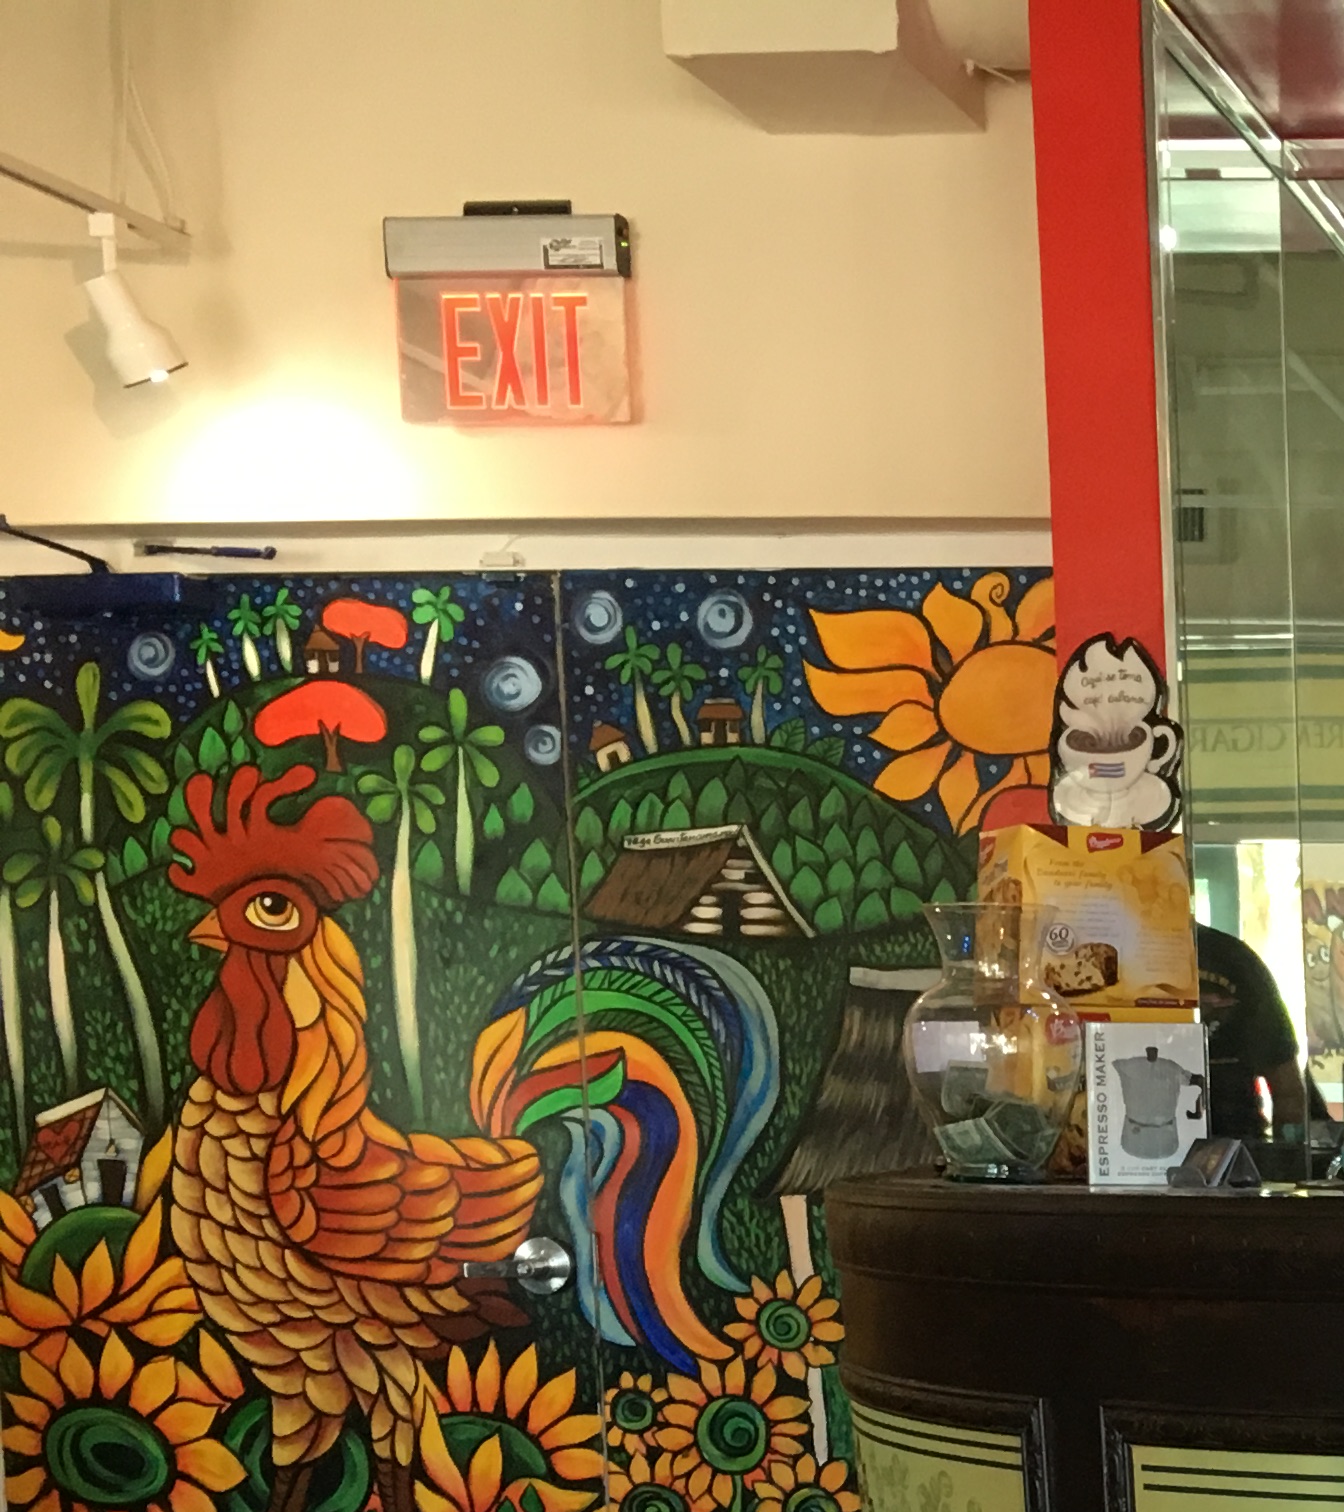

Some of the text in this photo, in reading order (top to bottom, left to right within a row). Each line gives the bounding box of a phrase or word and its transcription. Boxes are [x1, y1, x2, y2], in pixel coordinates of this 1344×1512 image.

[440, 293, 588, 410] EXIT
[1094, 1031, 1110, 1177] ESPRESSO MAKER
